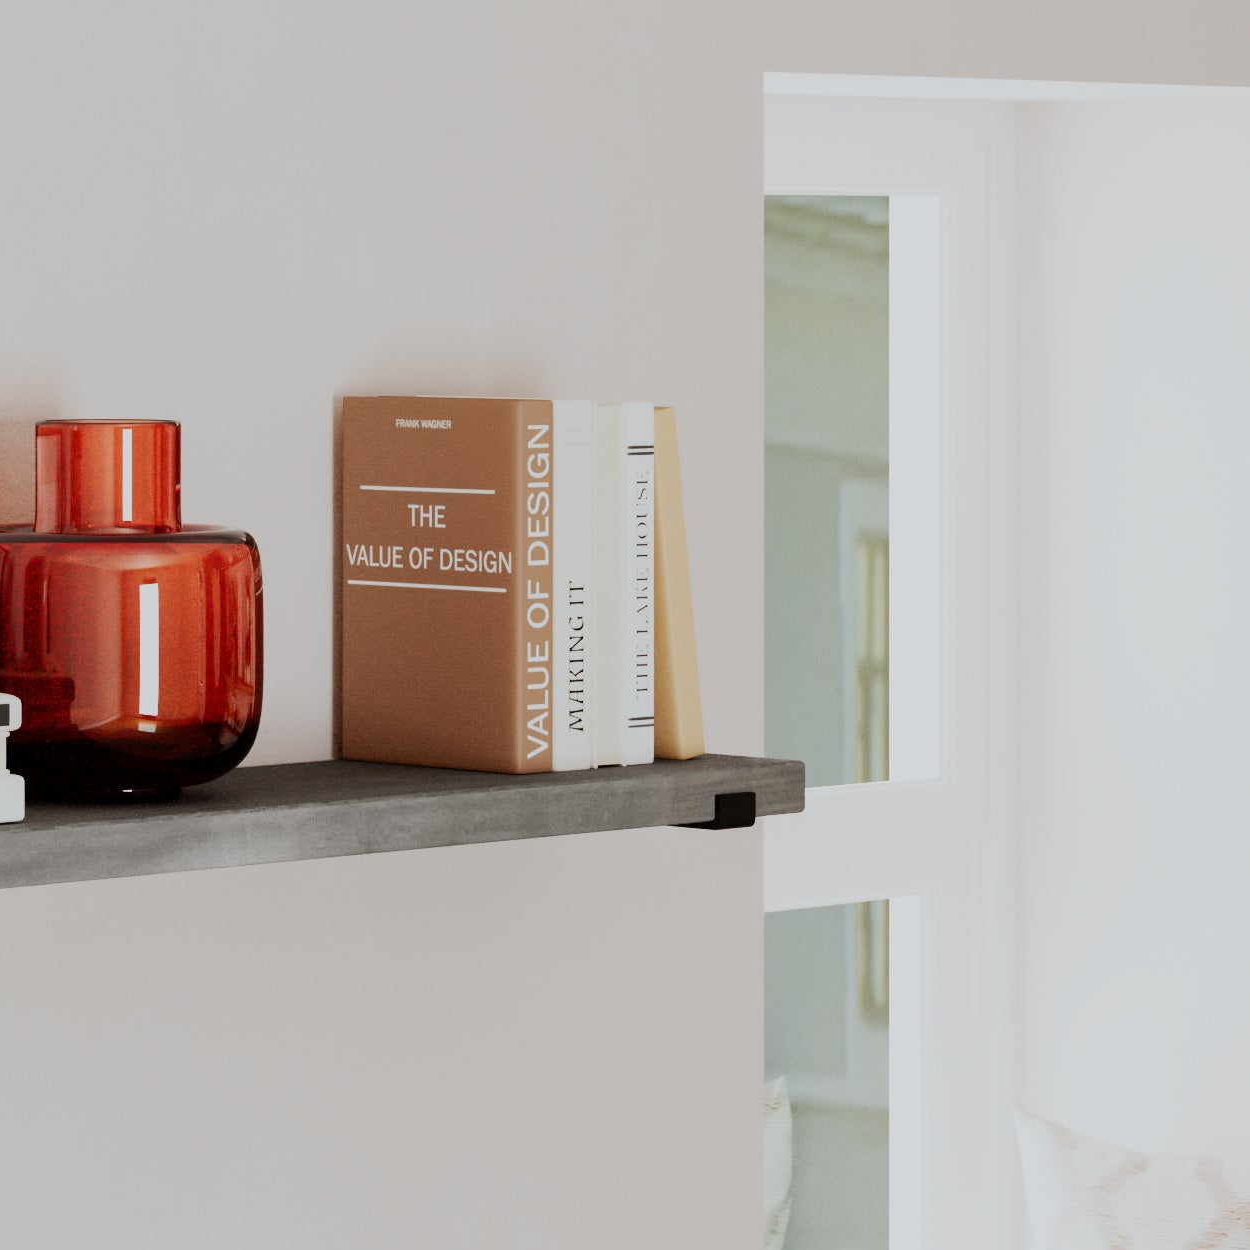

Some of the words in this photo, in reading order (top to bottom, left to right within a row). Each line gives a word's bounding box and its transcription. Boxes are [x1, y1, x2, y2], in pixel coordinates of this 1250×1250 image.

[395, 418, 420, 428] FRANK
[420, 419, 452, 430] WAGNER
[407, 504, 447, 528] THE
[527, 424, 550, 566] DESIGN
[635, 470, 649, 558] HOUSE
[345, 544, 404, 568] VALUE
[408, 546, 435, 570] OF
[439, 548, 512, 574] DESIGN
[526, 579, 549, 629] OF
[568, 580, 585, 606] IT
[635, 567, 649, 635] LAKE
[527, 640, 550, 760] VALUE
[568, 616, 585, 732] MAKING
[635, 643, 649, 700] THE
